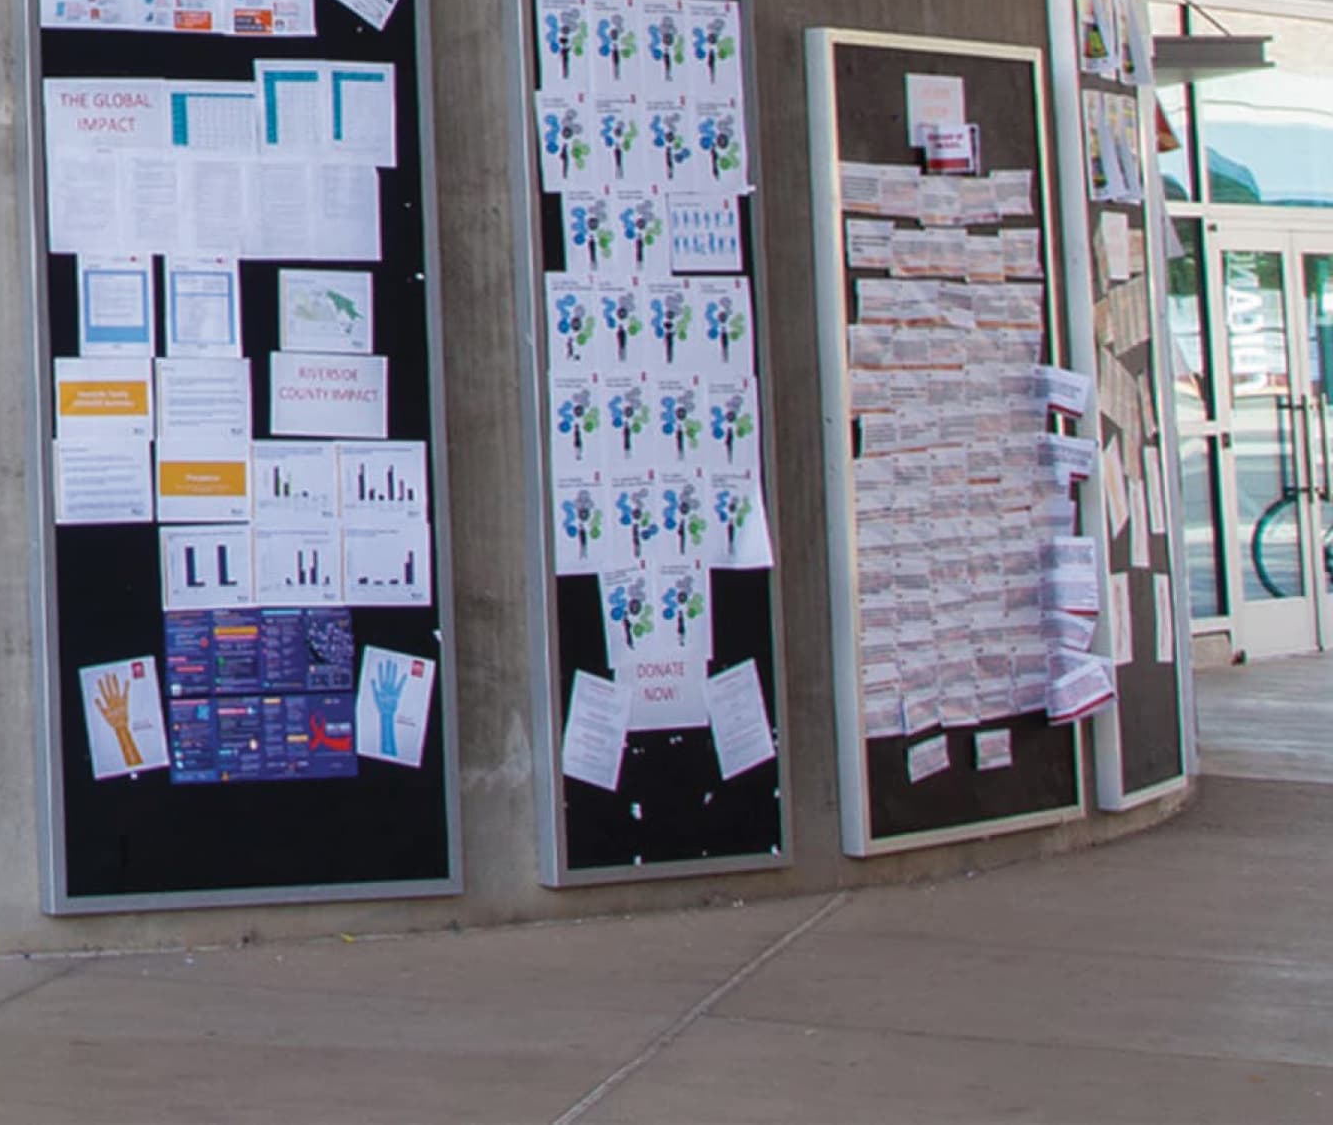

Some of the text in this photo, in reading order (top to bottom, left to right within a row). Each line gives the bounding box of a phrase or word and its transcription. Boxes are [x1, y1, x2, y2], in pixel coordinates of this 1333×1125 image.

[60, 93, 152, 109] THE GLOBAL
[76, 116, 136, 132] IMPACT
[637, 660, 685, 678] DONATE
